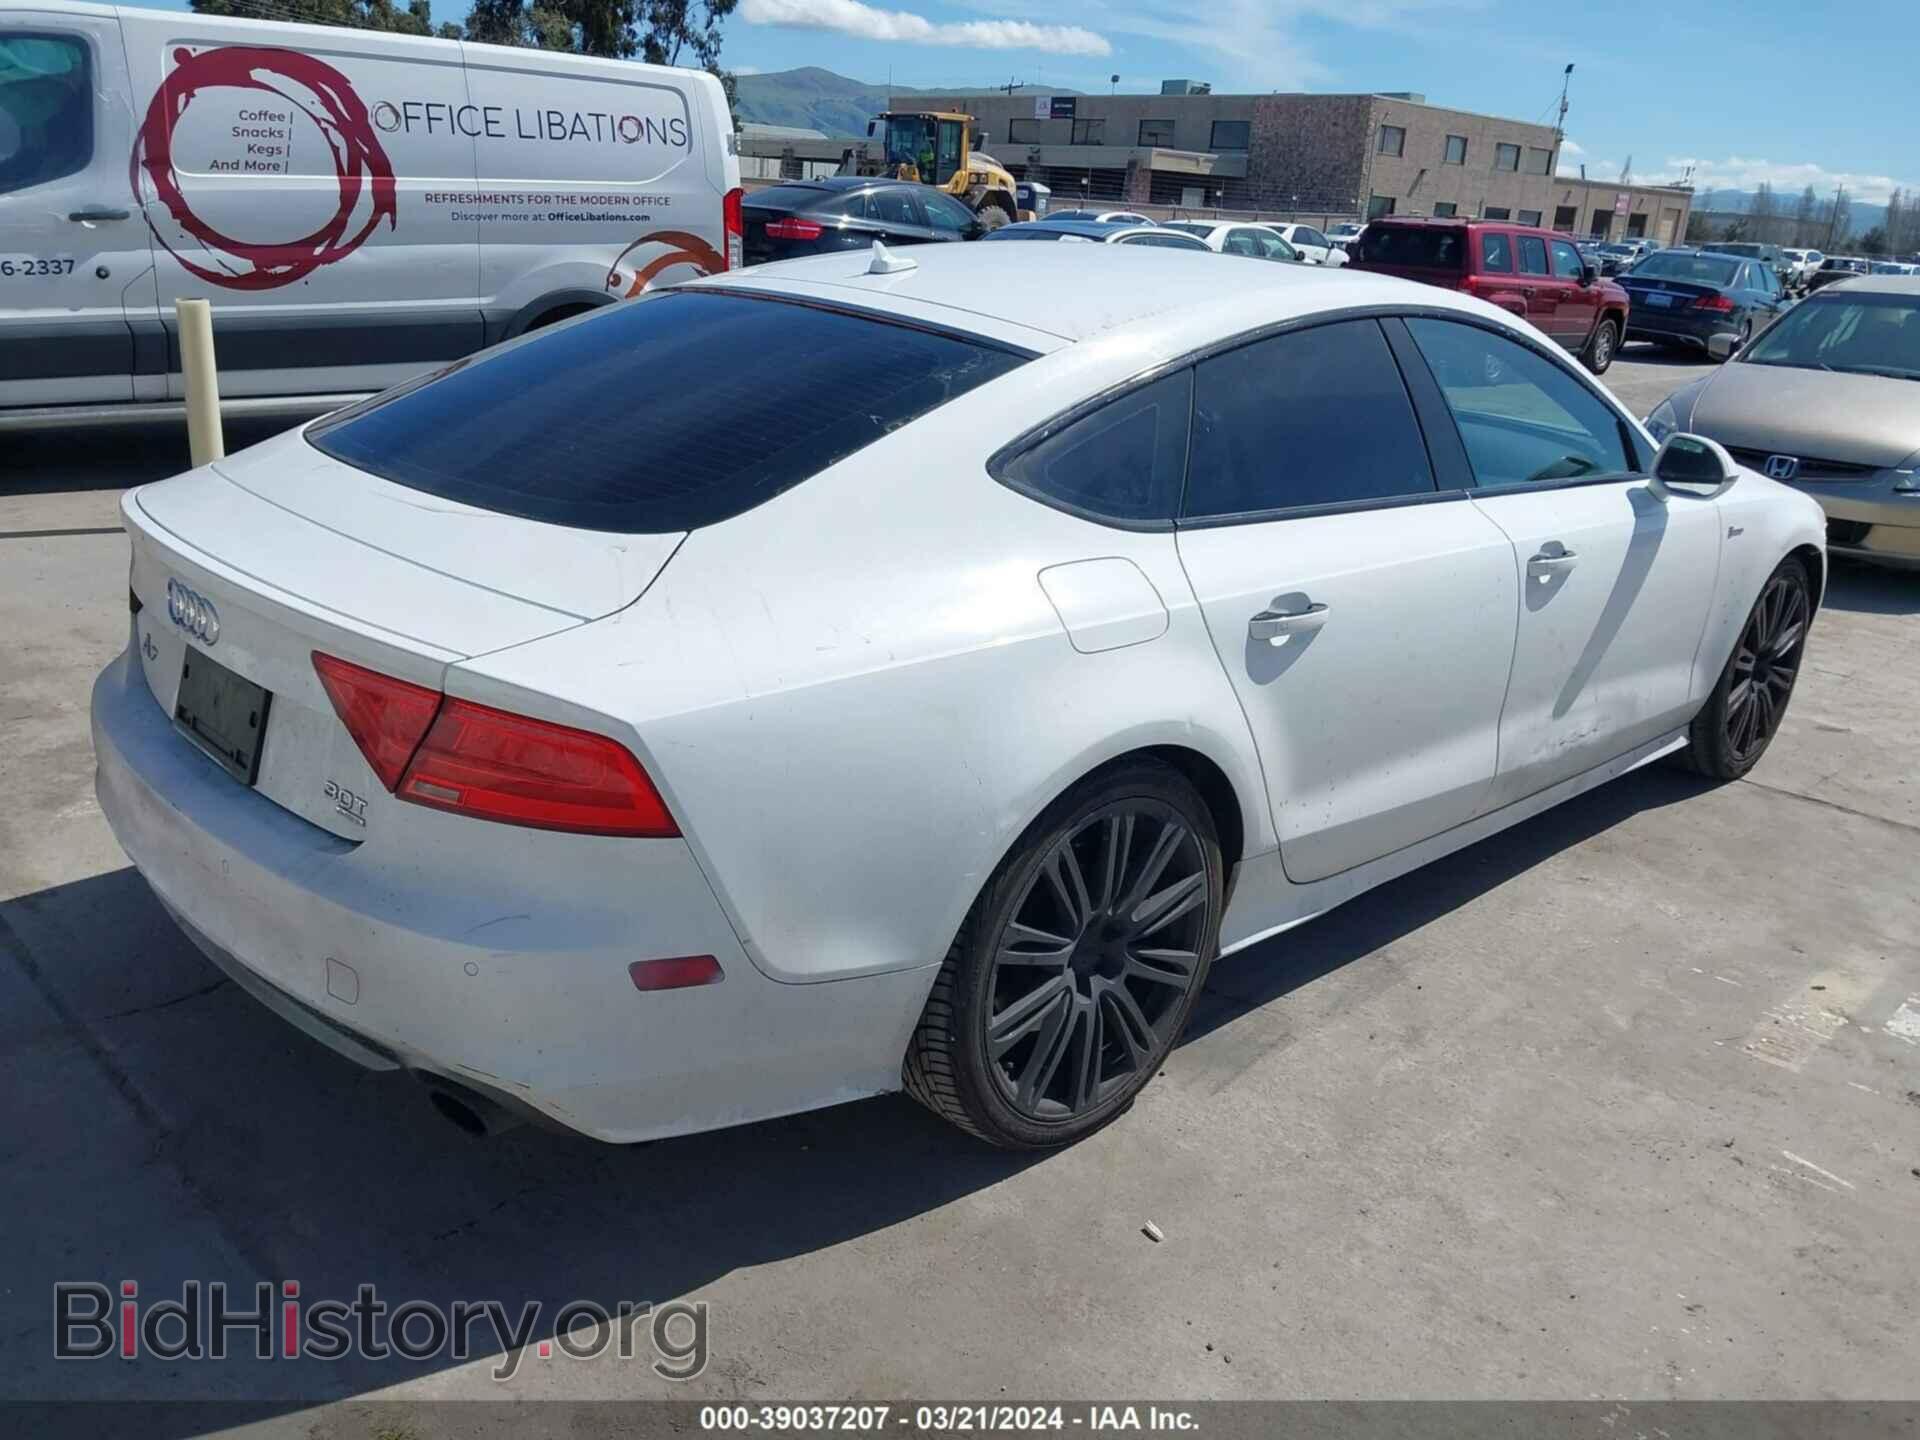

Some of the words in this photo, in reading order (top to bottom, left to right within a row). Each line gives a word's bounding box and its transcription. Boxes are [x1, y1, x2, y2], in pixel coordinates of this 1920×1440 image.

[238, 110, 286, 122] Coffee
[371, 100, 504, 138] OFFICE
[515, 108, 688, 147] LIBATIONS
[231, 126, 284, 138] Snacks
[247, 143, 283, 157] Kegs
[209, 159, 240, 171] And
[244, 160, 281, 172] More
[424, 193, 525, 205] REFRESHMENTS
[527, 194, 552, 205] FOR
[555, 195, 578, 205] THE
[580, 196, 631, 206] MODERN
[632, 196, 671, 206] OFFICE
[451, 211, 499, 222] Discover
[501, 213, 529, 222] more
[532, 212, 546, 222] at:
[547, 212, 651, 223] OfficeLibations.com
